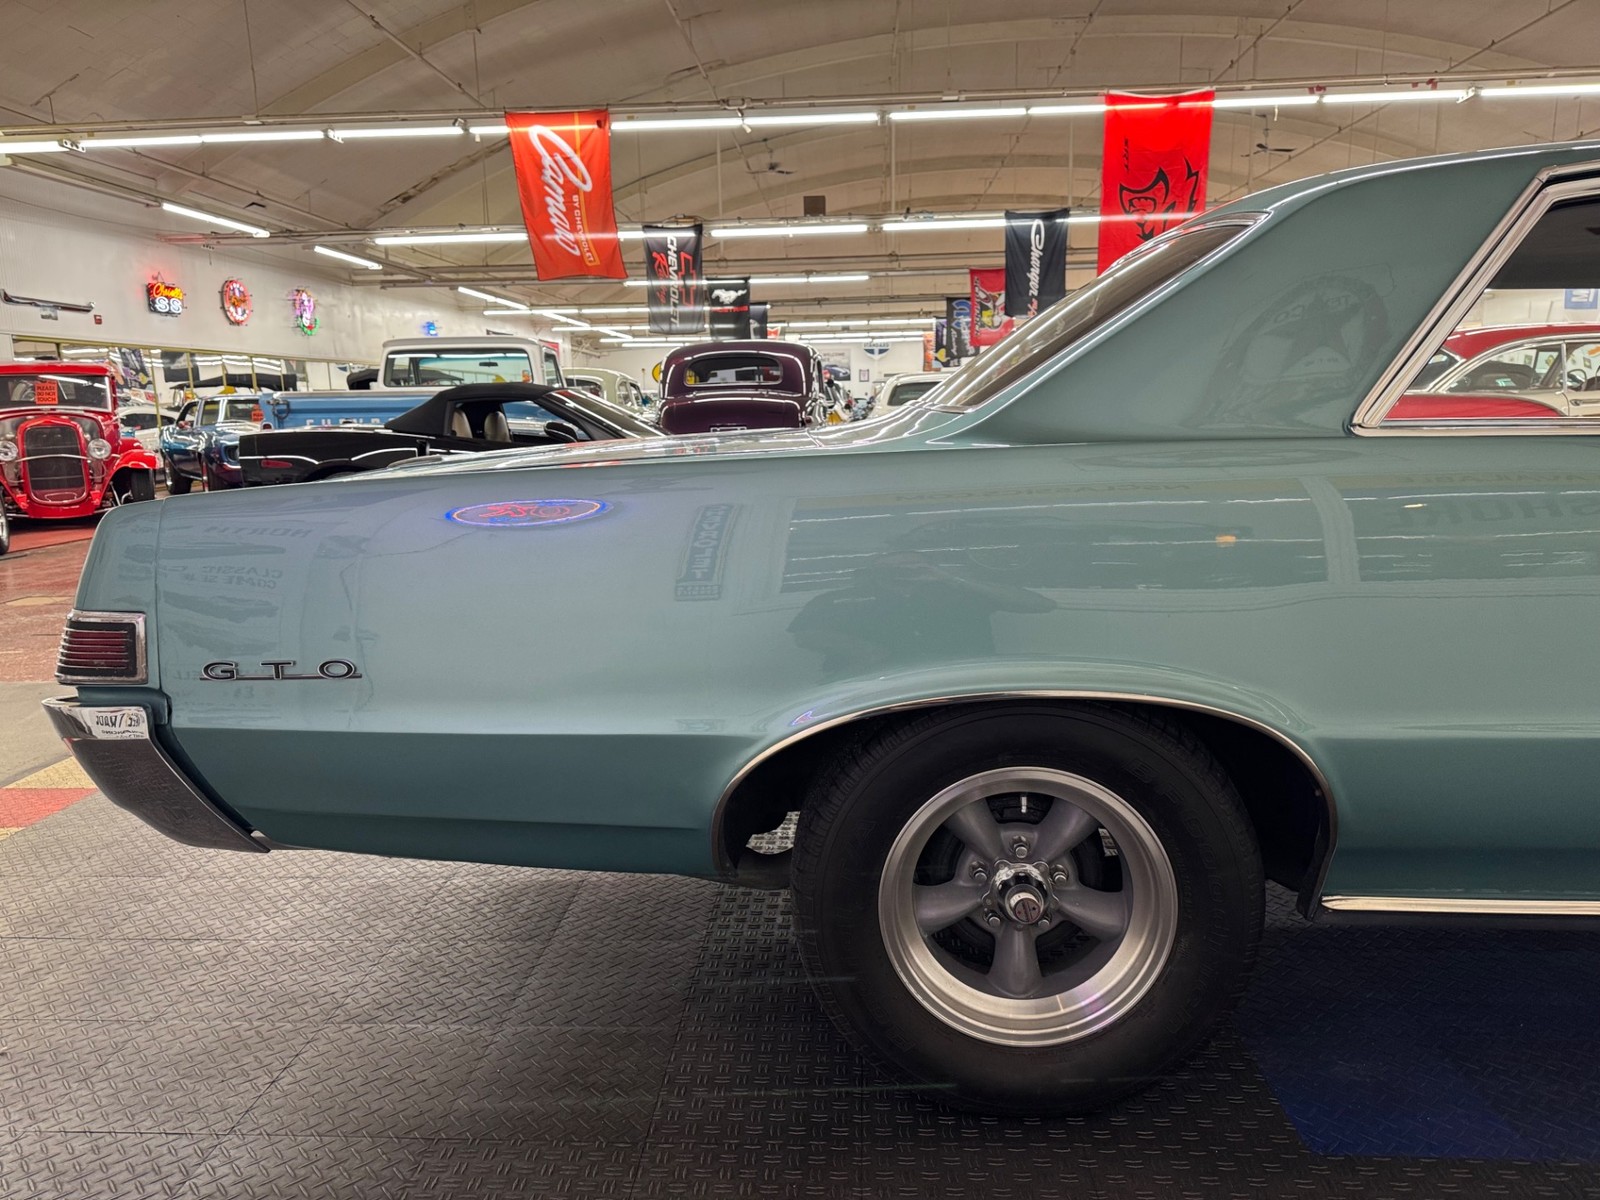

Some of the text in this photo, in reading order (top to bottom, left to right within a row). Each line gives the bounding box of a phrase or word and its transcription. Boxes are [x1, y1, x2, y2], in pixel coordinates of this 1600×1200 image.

[528, 124, 593, 257] Camaro
[571, 194, 596, 264] BY CHEVROLET
[1027, 219, 1045, 298] Charger
[155, 296, 182, 313] SS
[666, 236, 681, 327] CHEVROLET
[201, 658, 358, 681] GTO
